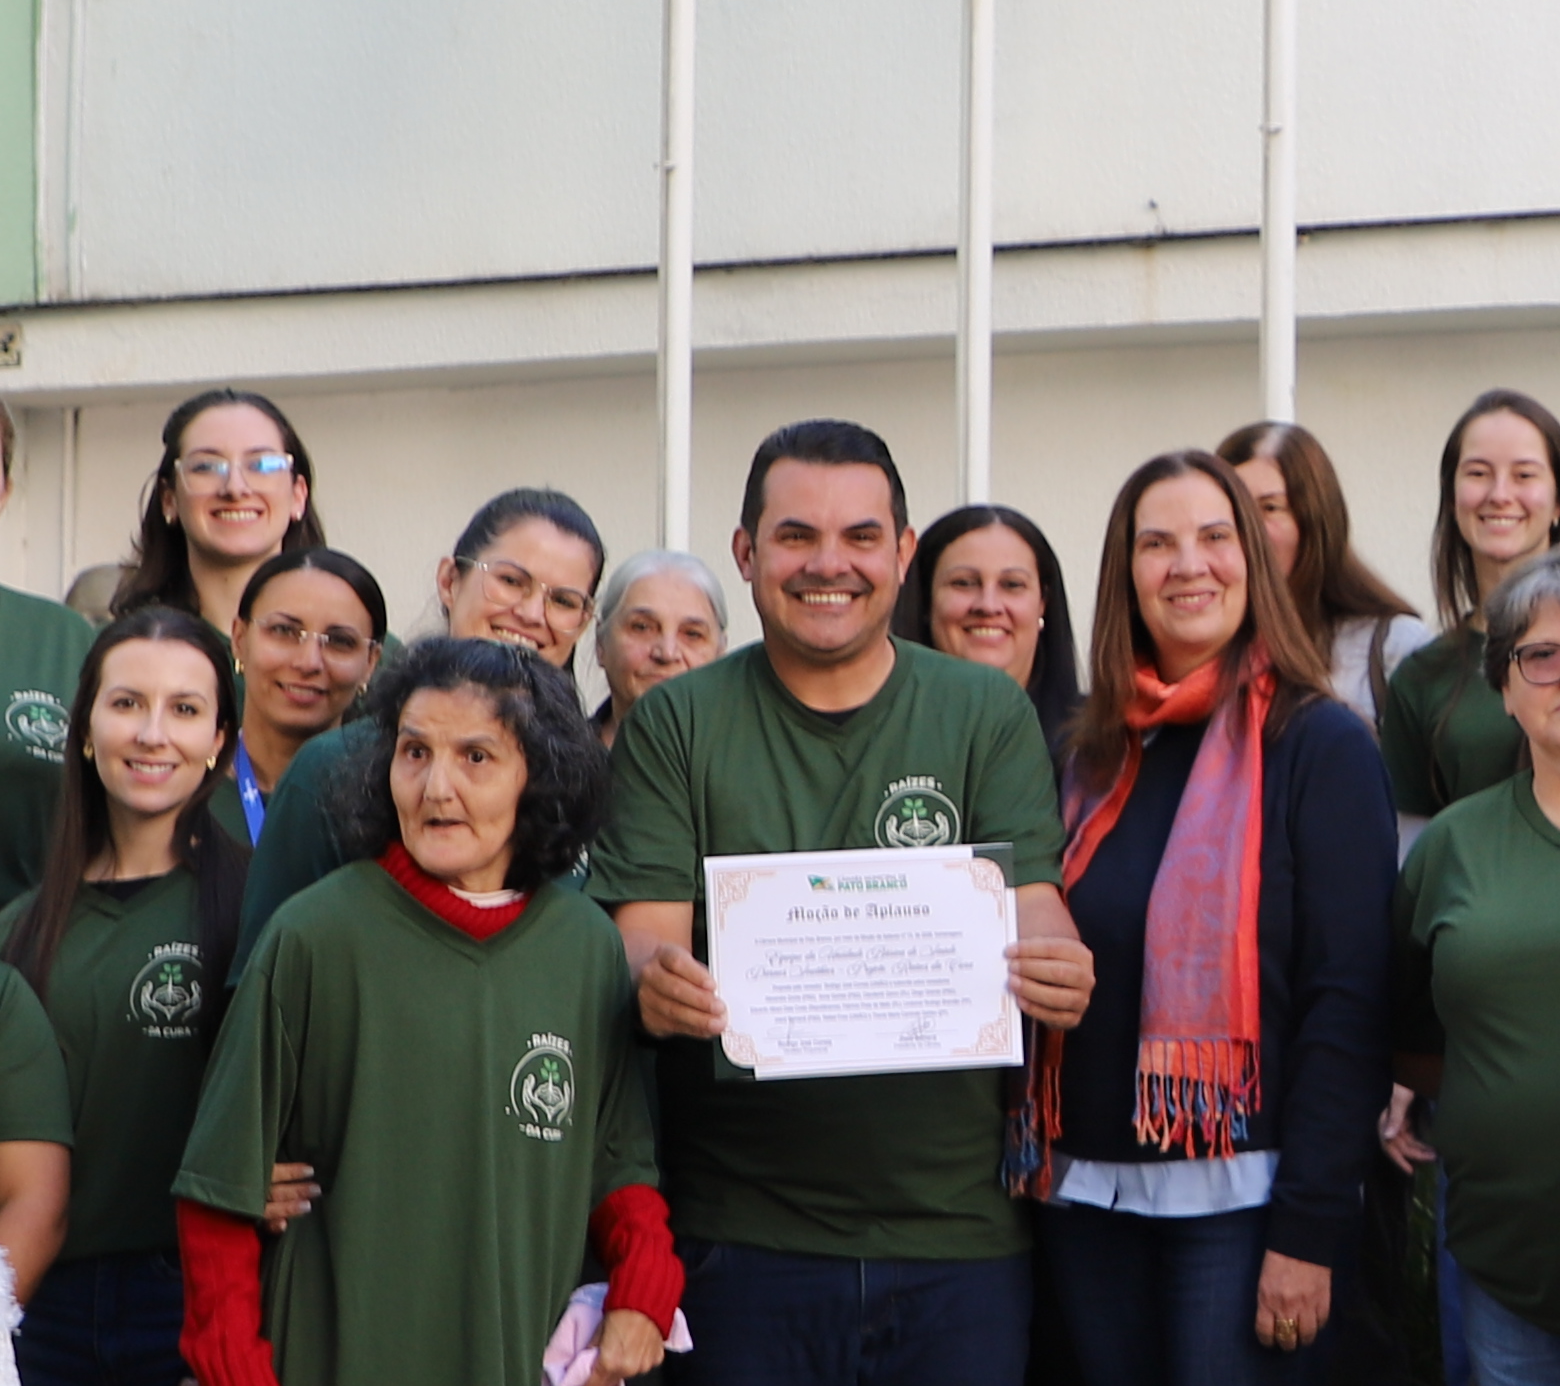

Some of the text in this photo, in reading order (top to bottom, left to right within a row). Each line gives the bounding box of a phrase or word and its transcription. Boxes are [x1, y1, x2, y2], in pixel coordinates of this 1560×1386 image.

[837, 878, 908, 892] PATO BRANCO
[787, 902, 931, 923] Moção de Aplauso
[532, 1032, 571, 1053] RAÍZES
